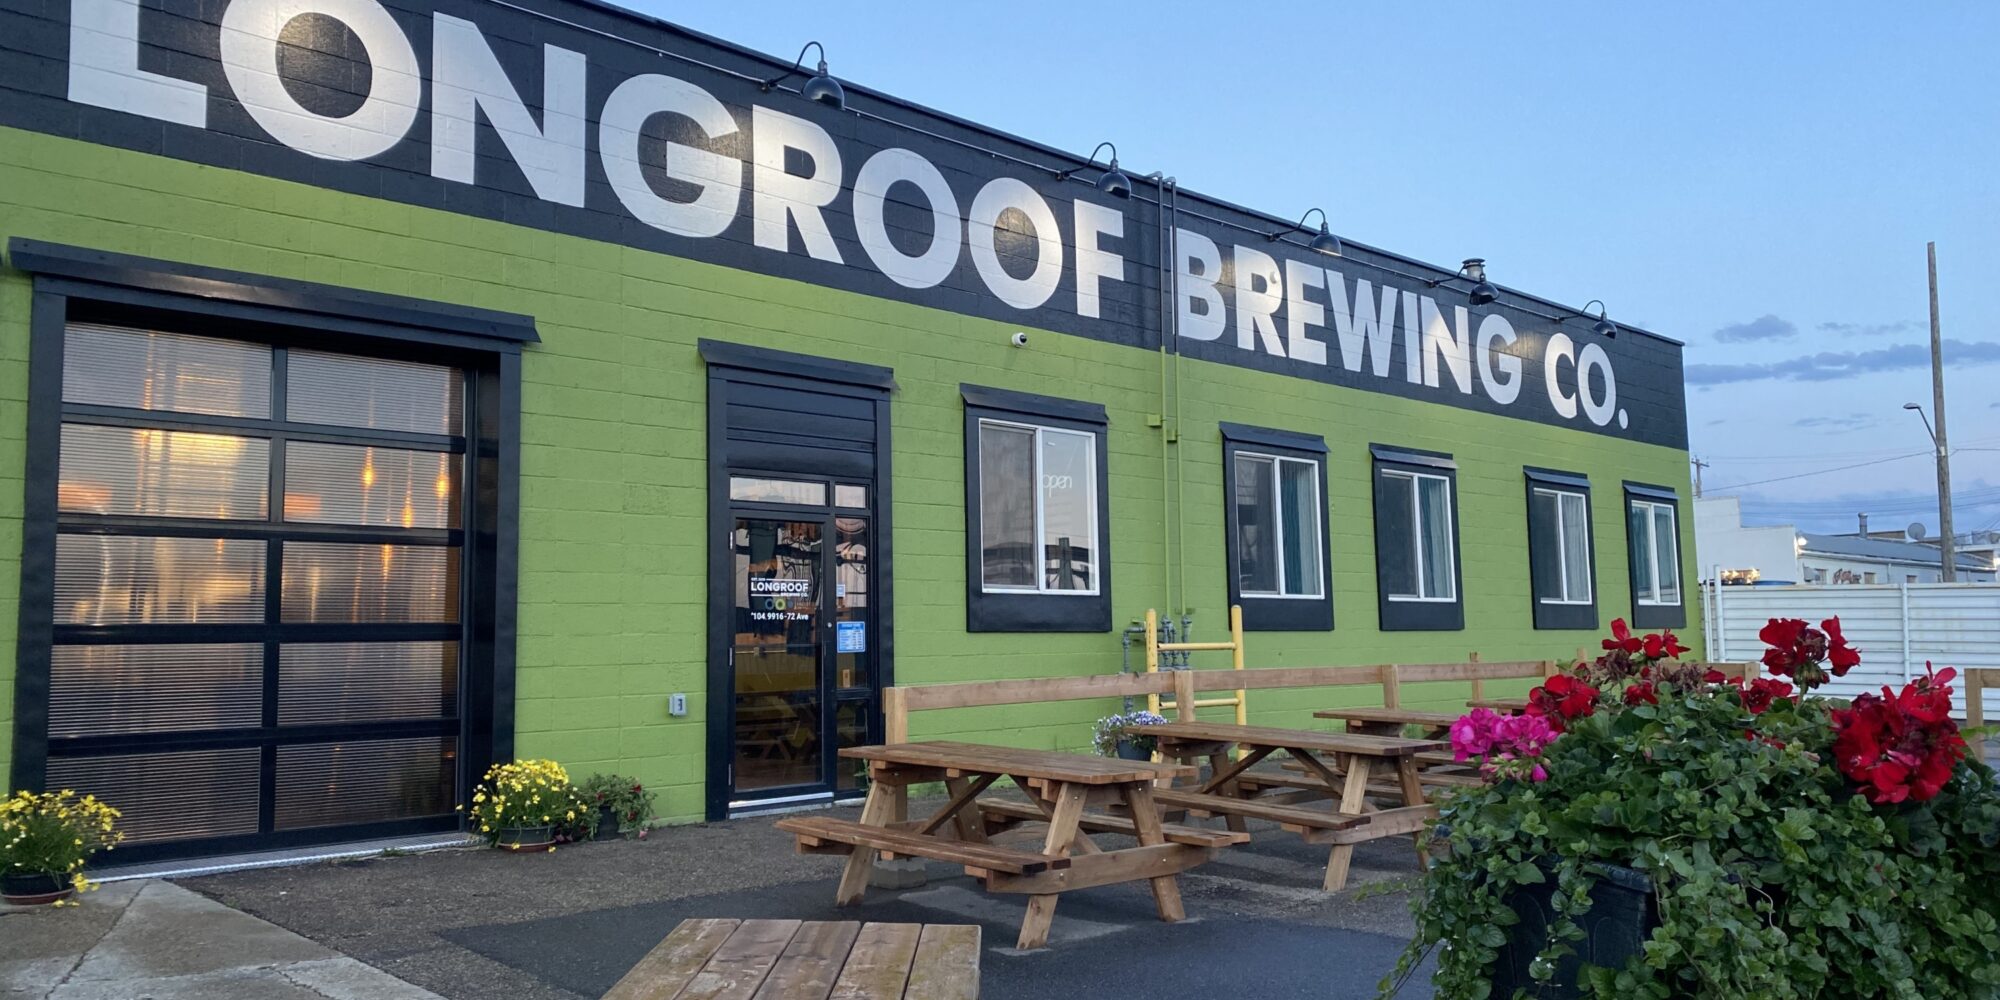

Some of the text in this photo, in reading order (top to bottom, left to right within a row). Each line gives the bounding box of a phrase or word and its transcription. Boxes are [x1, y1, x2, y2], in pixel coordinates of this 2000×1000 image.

[67, 0, 1629, 430] LONGROOF BREWING CO.
[751, 582, 809, 592] LONGROOF
[796, 612, 809, 621] Ave
